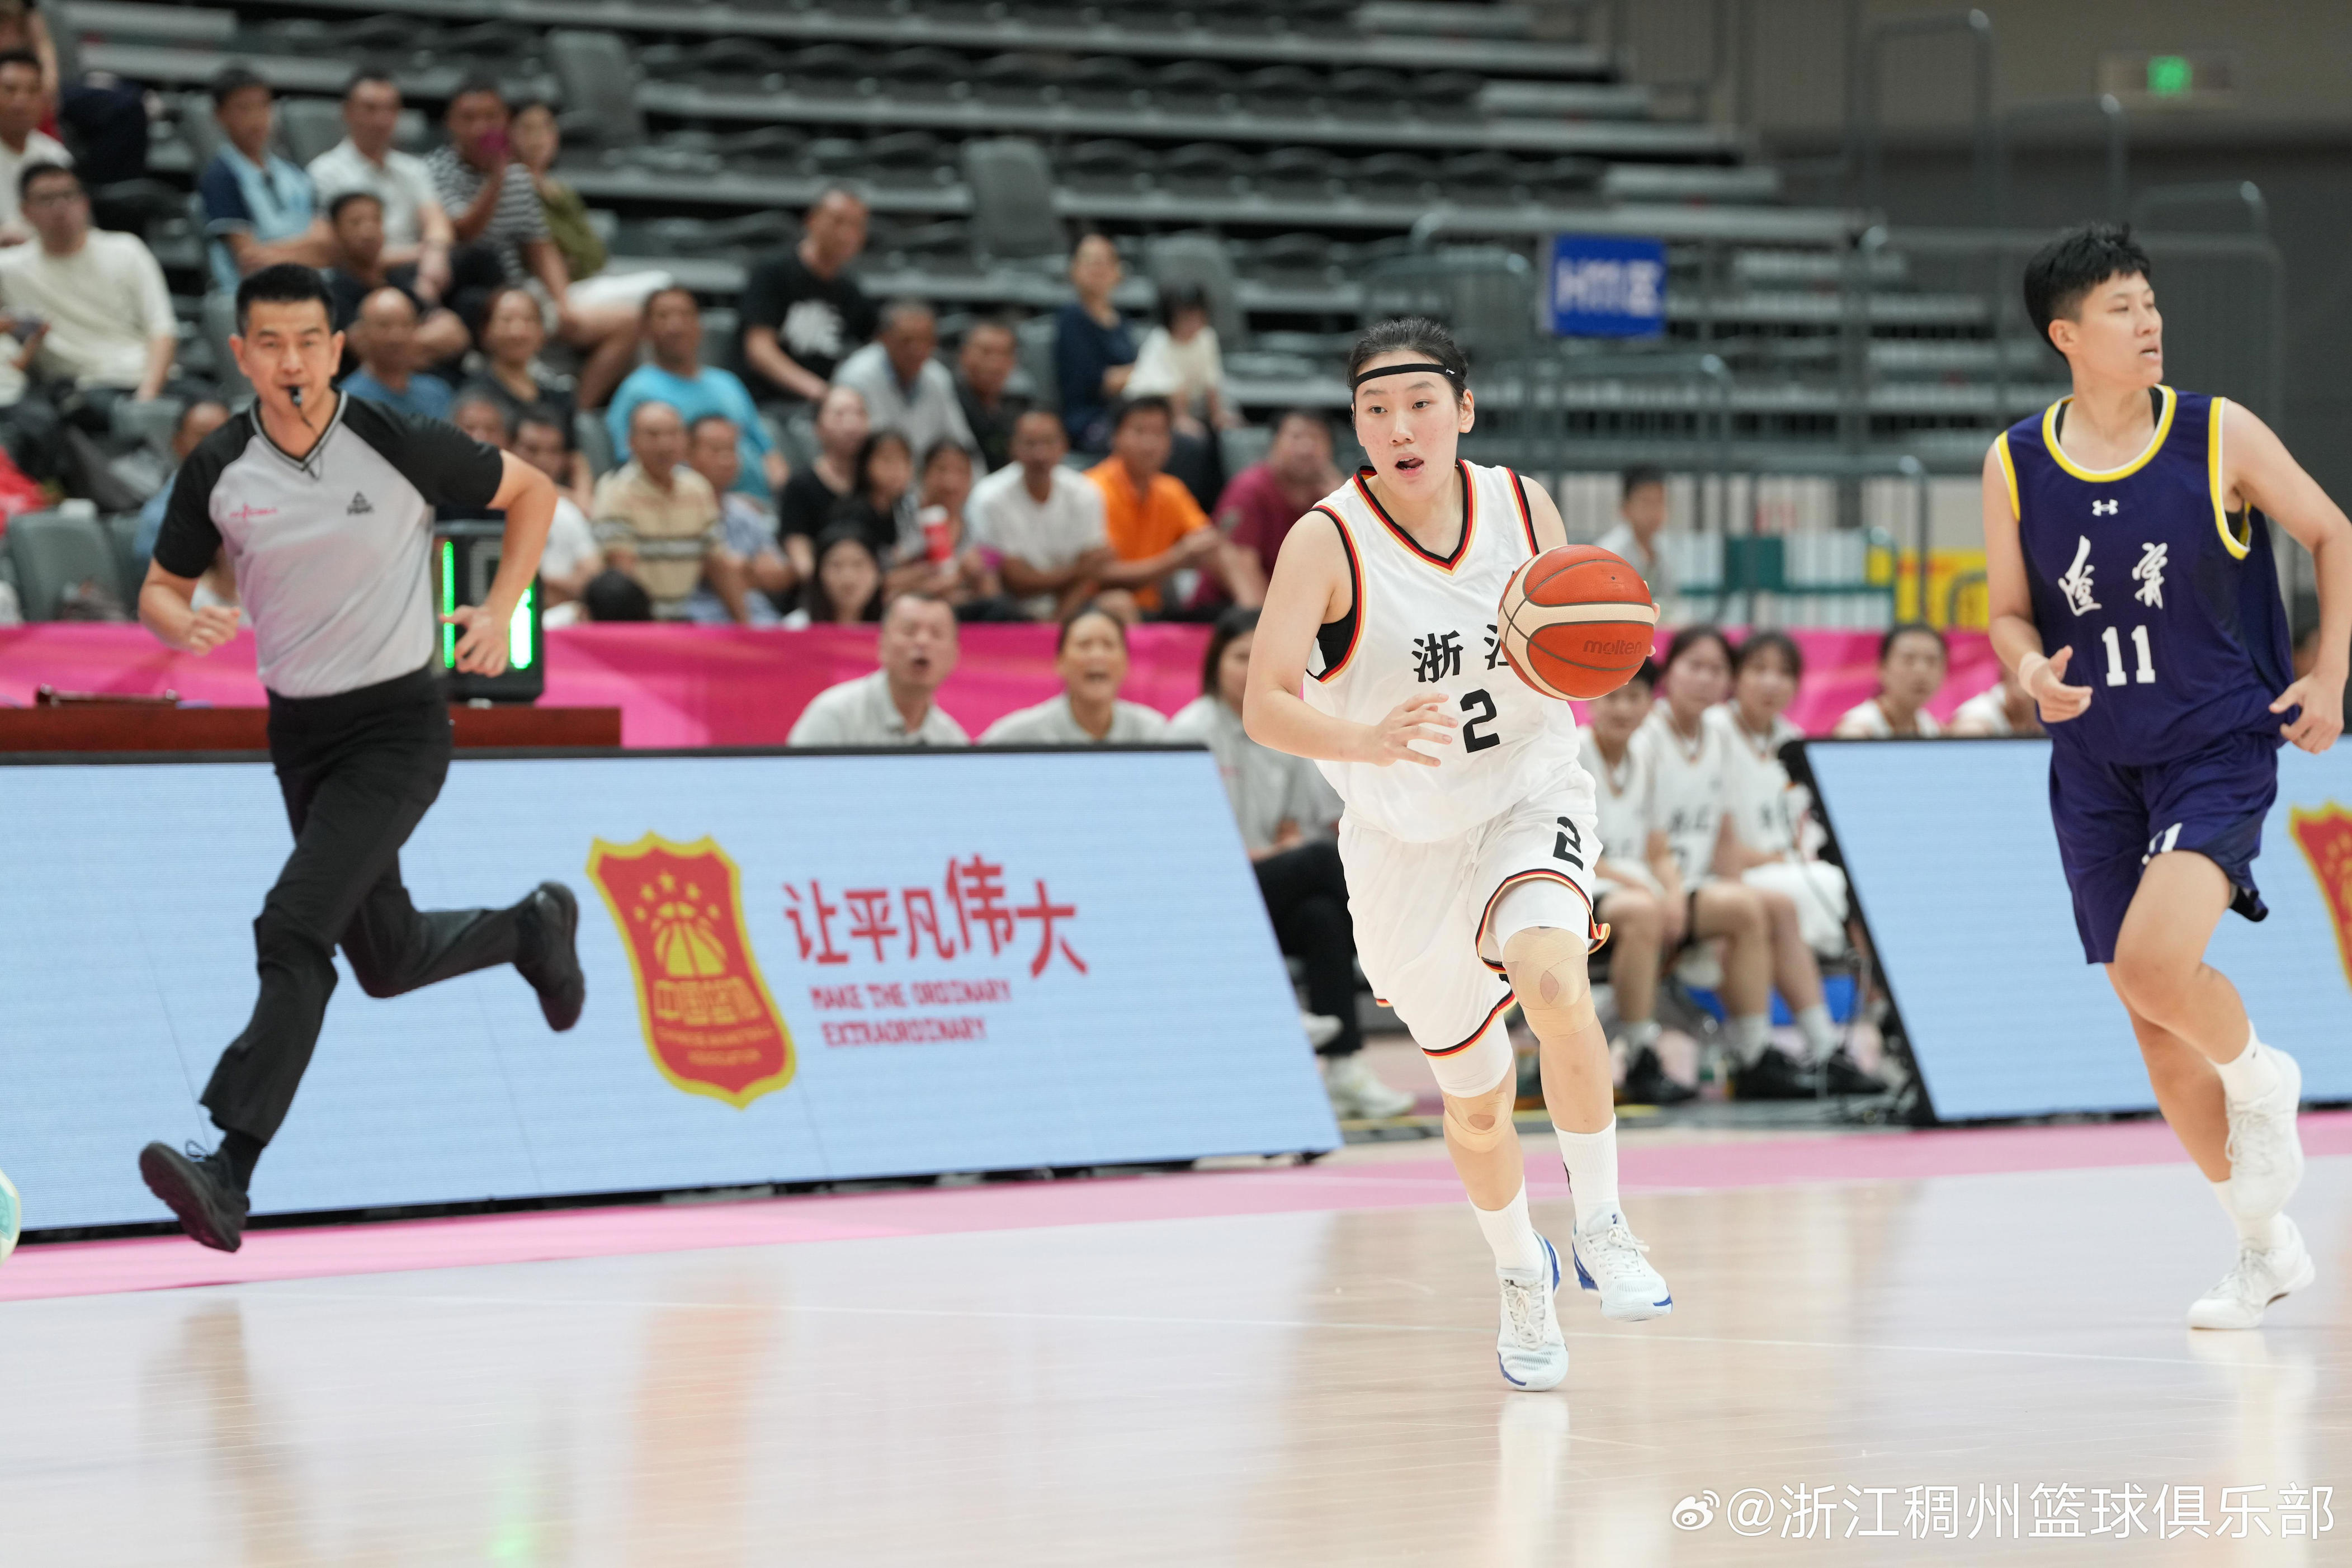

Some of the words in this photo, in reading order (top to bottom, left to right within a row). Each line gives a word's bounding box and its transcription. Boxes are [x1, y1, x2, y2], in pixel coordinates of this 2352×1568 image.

[1583, 640, 1642, 655] molten
[2101, 625, 2156, 686] 11
[1460, 688, 1500, 753] 2
[1553, 816, 1584, 871] 2
[783, 853, 1089, 979] 让平凡伟大
[810, 984, 864, 1010] MAKE
[866, 982, 907, 1008] THE
[911, 978, 1012, 1005] ORDINARY
[820, 1016, 987, 1048] EXTRAORDINARY
